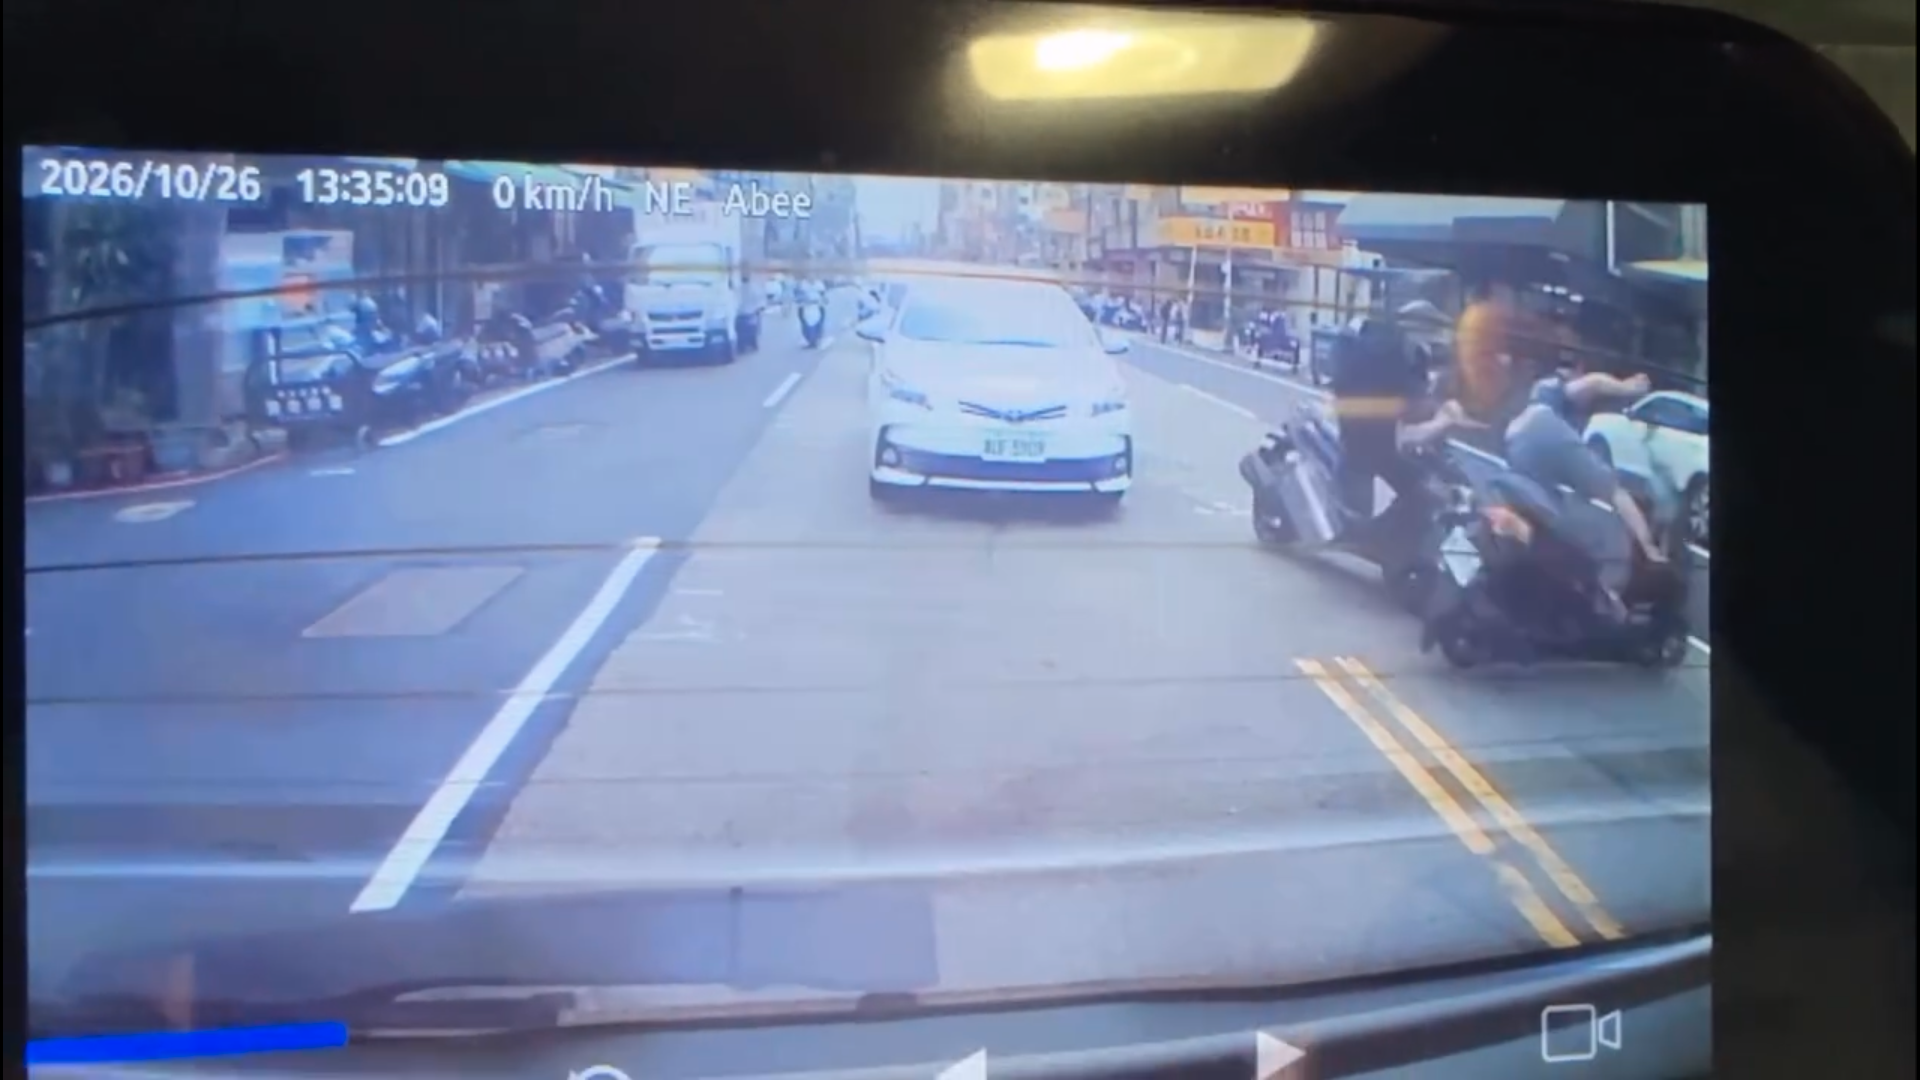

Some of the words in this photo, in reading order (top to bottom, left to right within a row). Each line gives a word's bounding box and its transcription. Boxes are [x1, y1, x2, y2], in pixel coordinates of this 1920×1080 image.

[40, 158, 262, 201] 2026/10/26
[296, 168, 449, 207] 13:35:09
[493, 175, 515, 209] 0
[524, 173, 614, 213] km/h
[645, 182, 694, 214] NE
[723, 181, 812, 218] Abee
